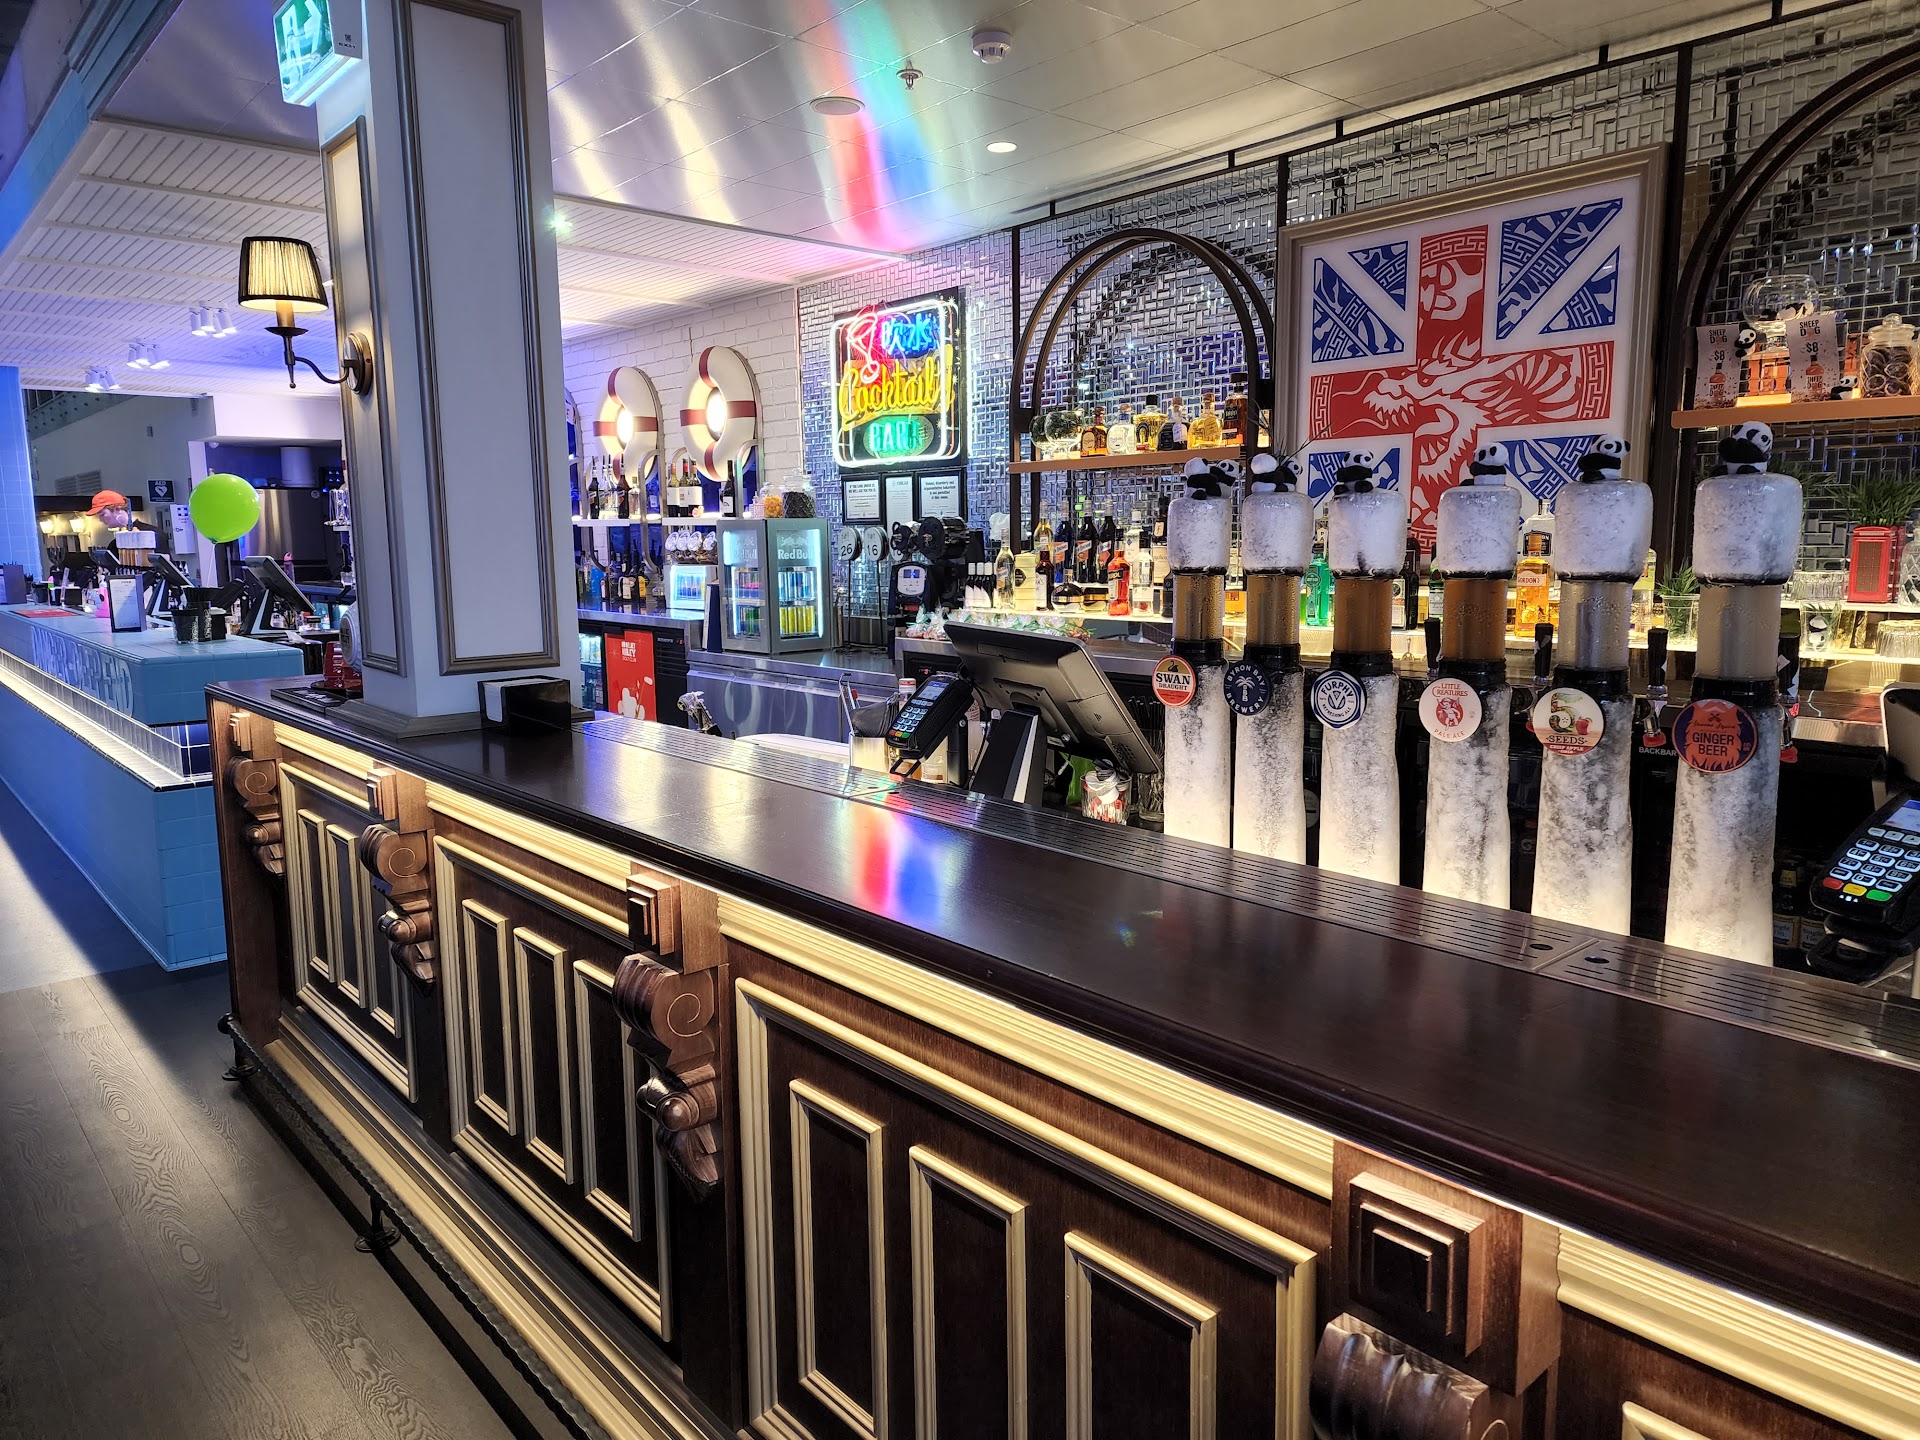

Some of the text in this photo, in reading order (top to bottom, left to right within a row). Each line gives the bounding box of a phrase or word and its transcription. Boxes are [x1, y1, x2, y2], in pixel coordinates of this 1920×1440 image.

[1799, 319, 1820, 329] SHEEP
[1806, 341, 1819, 353] $8
[1714, 349, 1725, 361] $8
[778, 548, 796, 560] Red
[840, 543, 853, 557] 26
[867, 544, 878, 556] 16
[1156, 672, 1191, 685] SWAN
[1226, 664, 1266, 686] BYRON BAY
[1158, 682, 1188, 690] DRAUGHT
[1320, 680, 1354, 697] FURPHY
[1432, 686, 1468, 698] CREATURES
[1226, 692, 1264, 713] BREWERY
[1322, 704, 1345, 718] REFRESHING
[1434, 728, 1466, 739] PALE ALE
[1548, 734, 1585, 744] SEEDS
[1692, 732, 1734, 746] GINGER
[1638, 746, 1677, 757] BACKBAR
[1698, 744, 1728, 756] BEER
